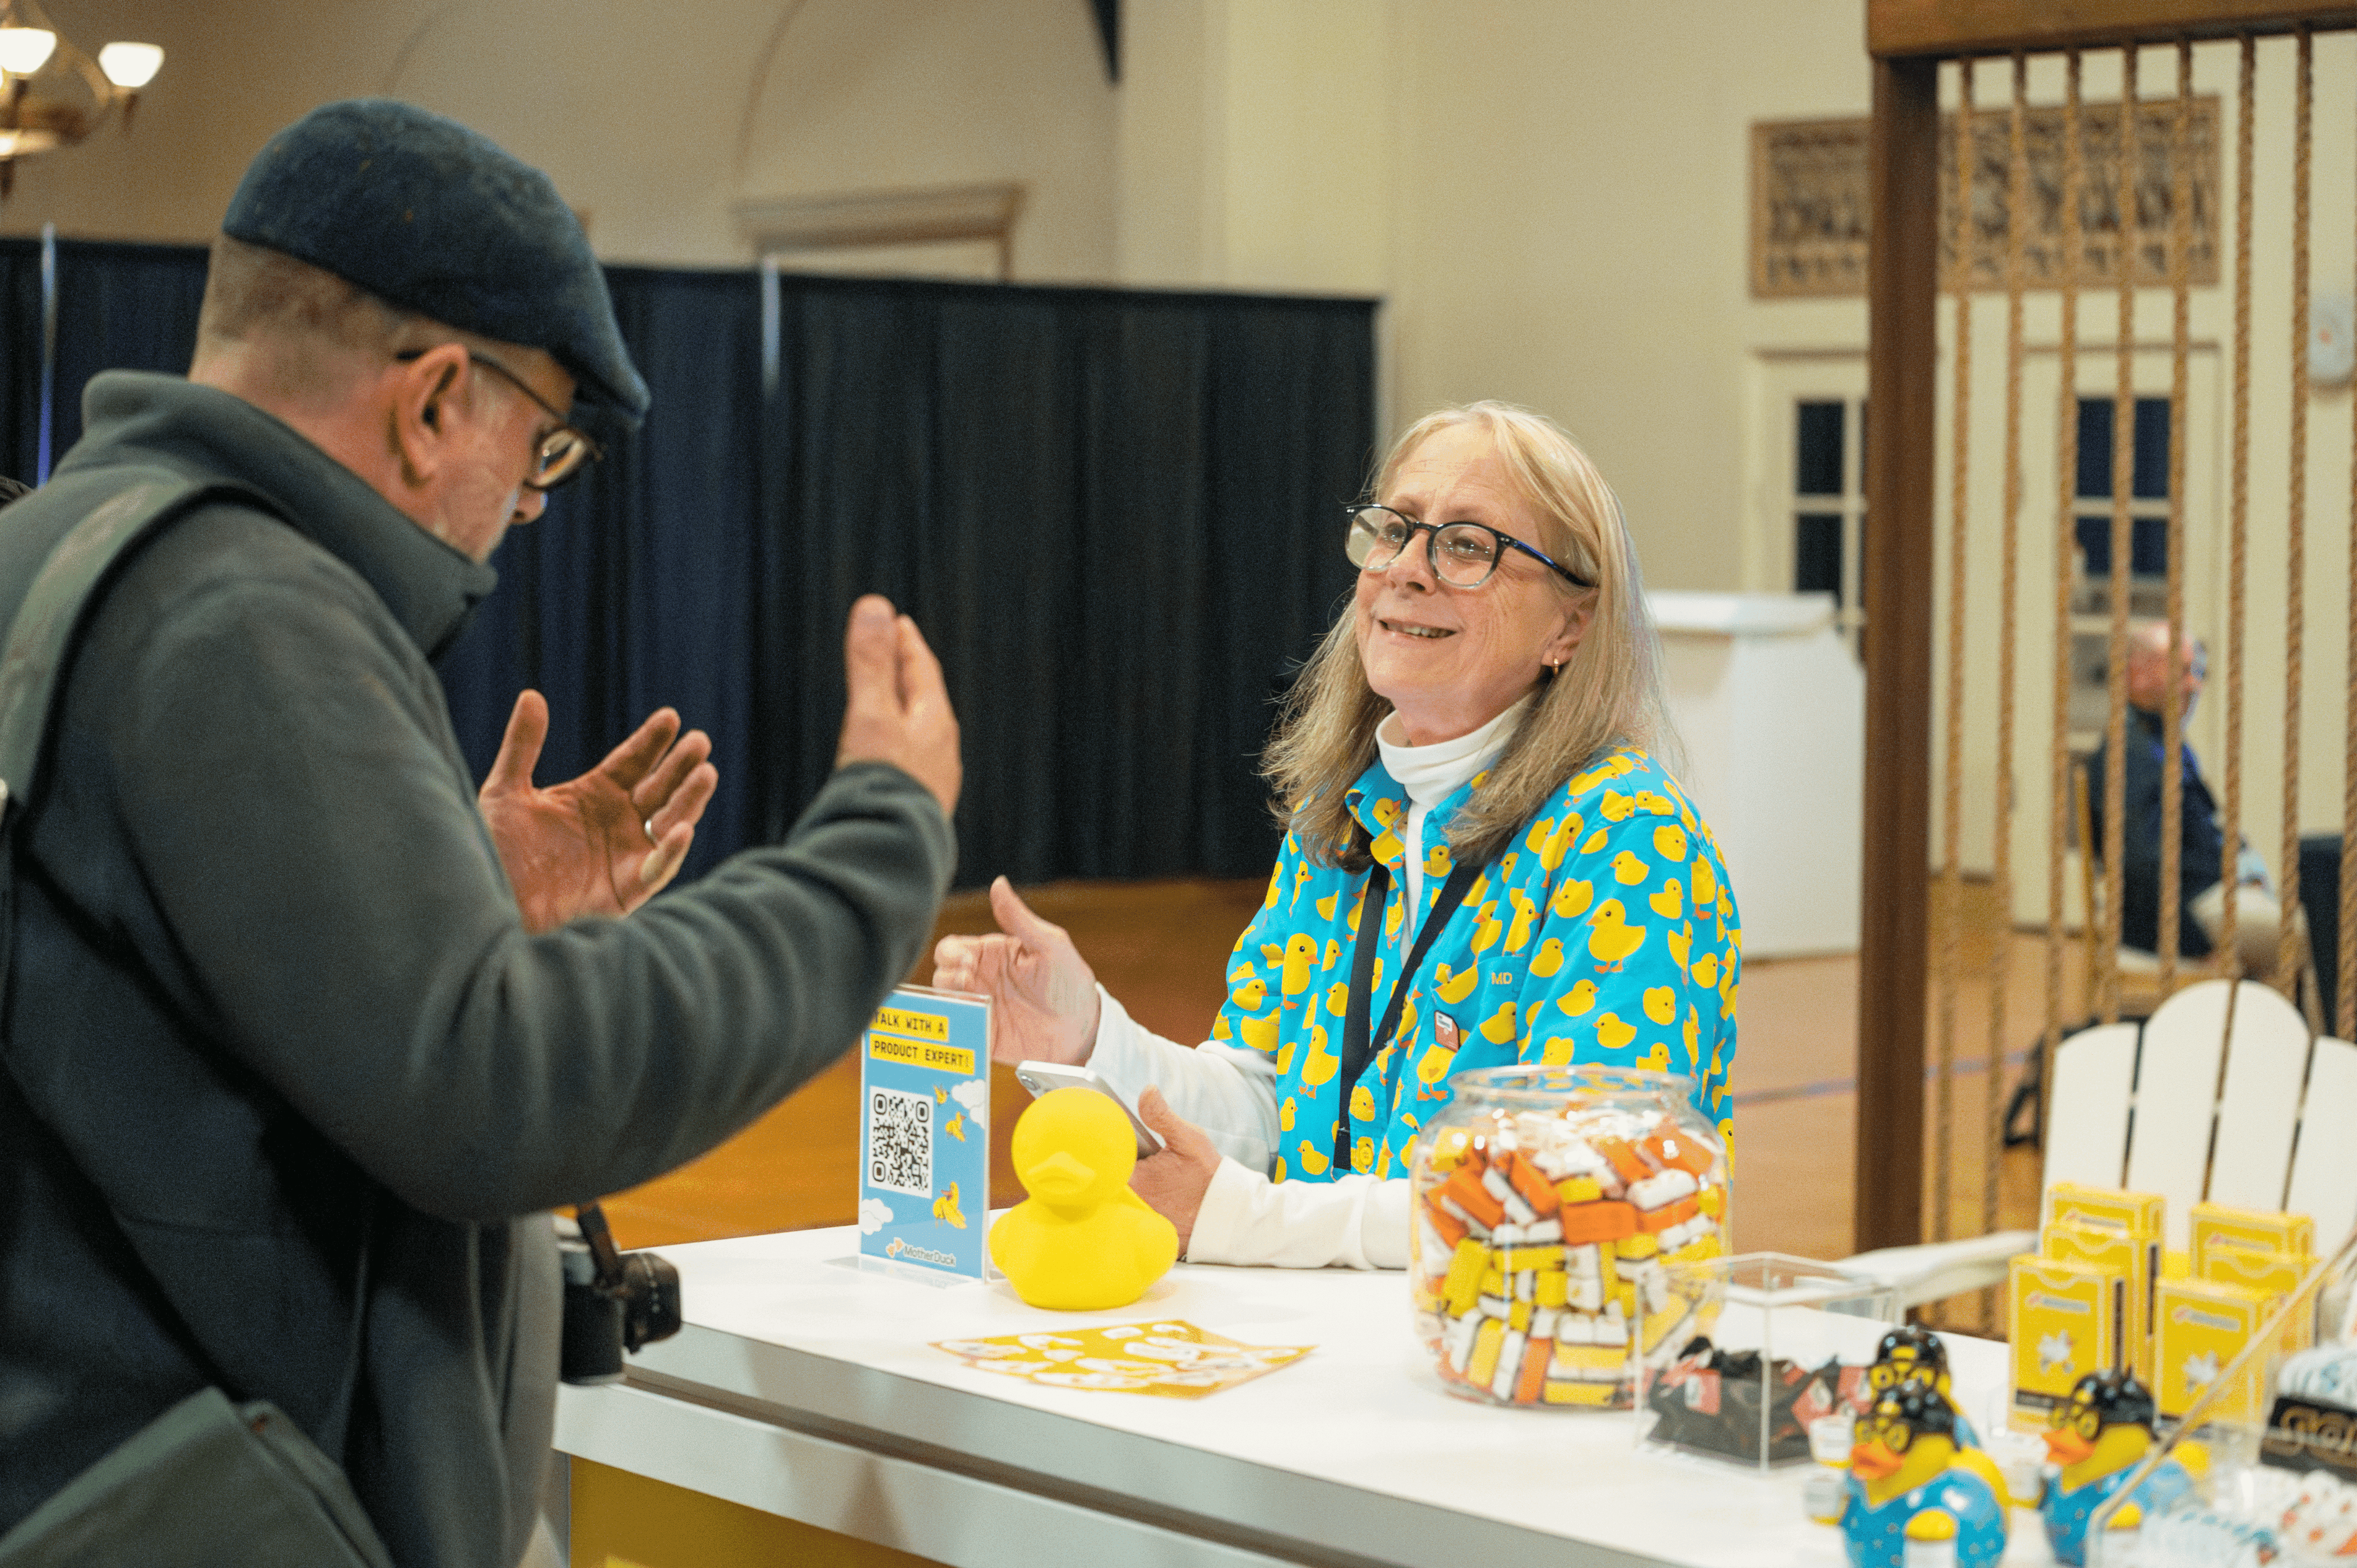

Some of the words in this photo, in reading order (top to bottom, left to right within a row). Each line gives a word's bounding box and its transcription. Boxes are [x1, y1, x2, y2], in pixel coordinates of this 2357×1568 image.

[1491, 971, 1512, 984] MD
[906, 1017, 931, 1032] WITH
[938, 1022, 944, 1034] A
[874, 1041, 918, 1059] PRODUCT
[925, 1049, 969, 1067] EXPERT!
[904, 1245, 955, 1265] MotherDuck
